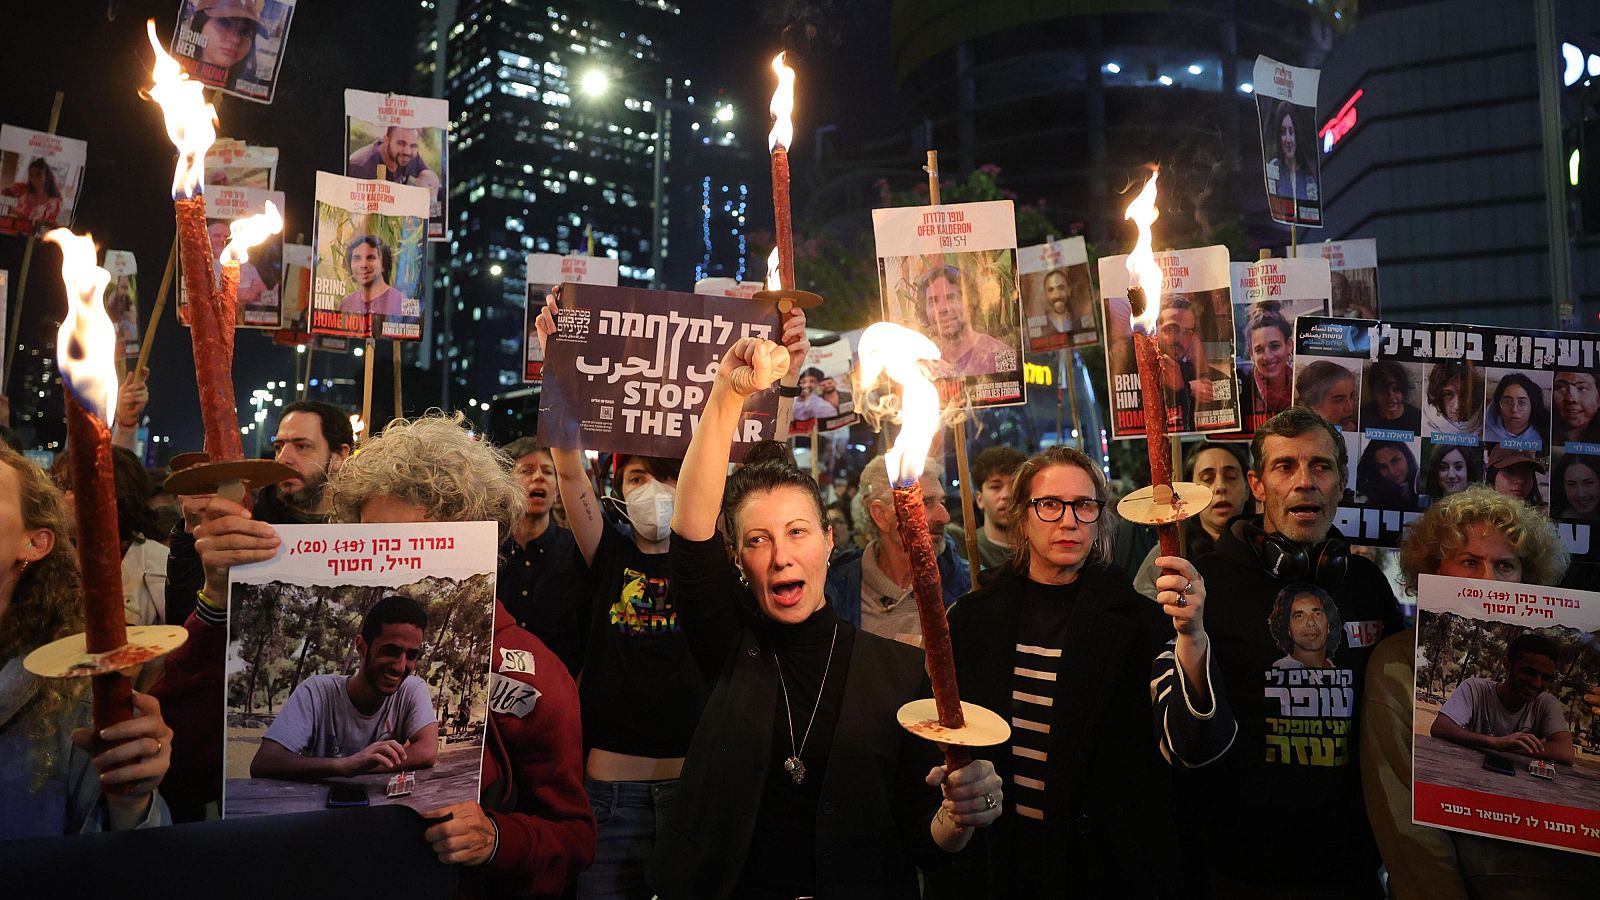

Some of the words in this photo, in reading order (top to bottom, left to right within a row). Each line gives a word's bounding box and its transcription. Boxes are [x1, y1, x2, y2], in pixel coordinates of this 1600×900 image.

[175, 42, 196, 58] HER
[350, 191, 366, 201] OFER
[947, 210, 965, 222] עופר
[917, 225, 935, 237] OFER
[937, 223, 972, 235] KALDERON
[953, 235, 967, 246] 54
[1169, 267, 1189, 277] COHEN
[1260, 264, 1278, 275] ארבל
[315, 278, 346, 295] BRING
[1240, 278, 1259, 289] ARBEL
[1260, 274, 1286, 286] YEHOUD
[314, 293, 335, 310] HIM
[1245, 288, 1264, 300] (29)
[313, 311, 343, 328] HOME
[344, 314, 372, 332] NOW!
[599, 310, 733, 345] למלחמה
[1367, 324, 1484, 363] בשבילן
[1494, 334, 1600, 369] ועקות
[1114, 374, 1143, 391] BRIN
[623, 381, 704, 409] STOP
[976, 389, 1001, 399] FAMILIES
[1001, 387, 1020, 397] FORUM
[1116, 391, 1139, 409] HIM
[621, 409, 682, 437] THE
[1117, 410, 1147, 428] HOM
[373, 538, 401, 552] כהן
[409, 537, 455, 550] נמרוד
[327, 558, 373, 576] חטוף
[380, 555, 422, 573] חייל,
[1514, 593, 1537, 604] כהן
[1542, 596, 1581, 609] נמרוד
[1482, 603, 1516, 615] חטוף
[1520, 605, 1553, 619] חייל,
[1265, 667, 1285, 685] לי
[1289, 669, 1353, 687] קוראים
[490, 680, 536, 709] 467
[1265, 687, 1354, 717] עופר
[1265, 718, 1323, 736] מופקר
[1265, 735, 1348, 767] בעזה
[1440, 802, 1472, 816] בשבי
[1475, 808, 1521, 825] להשאר
[1525, 816, 1539, 828] לו
[1544, 820, 1576, 834] תתנו
